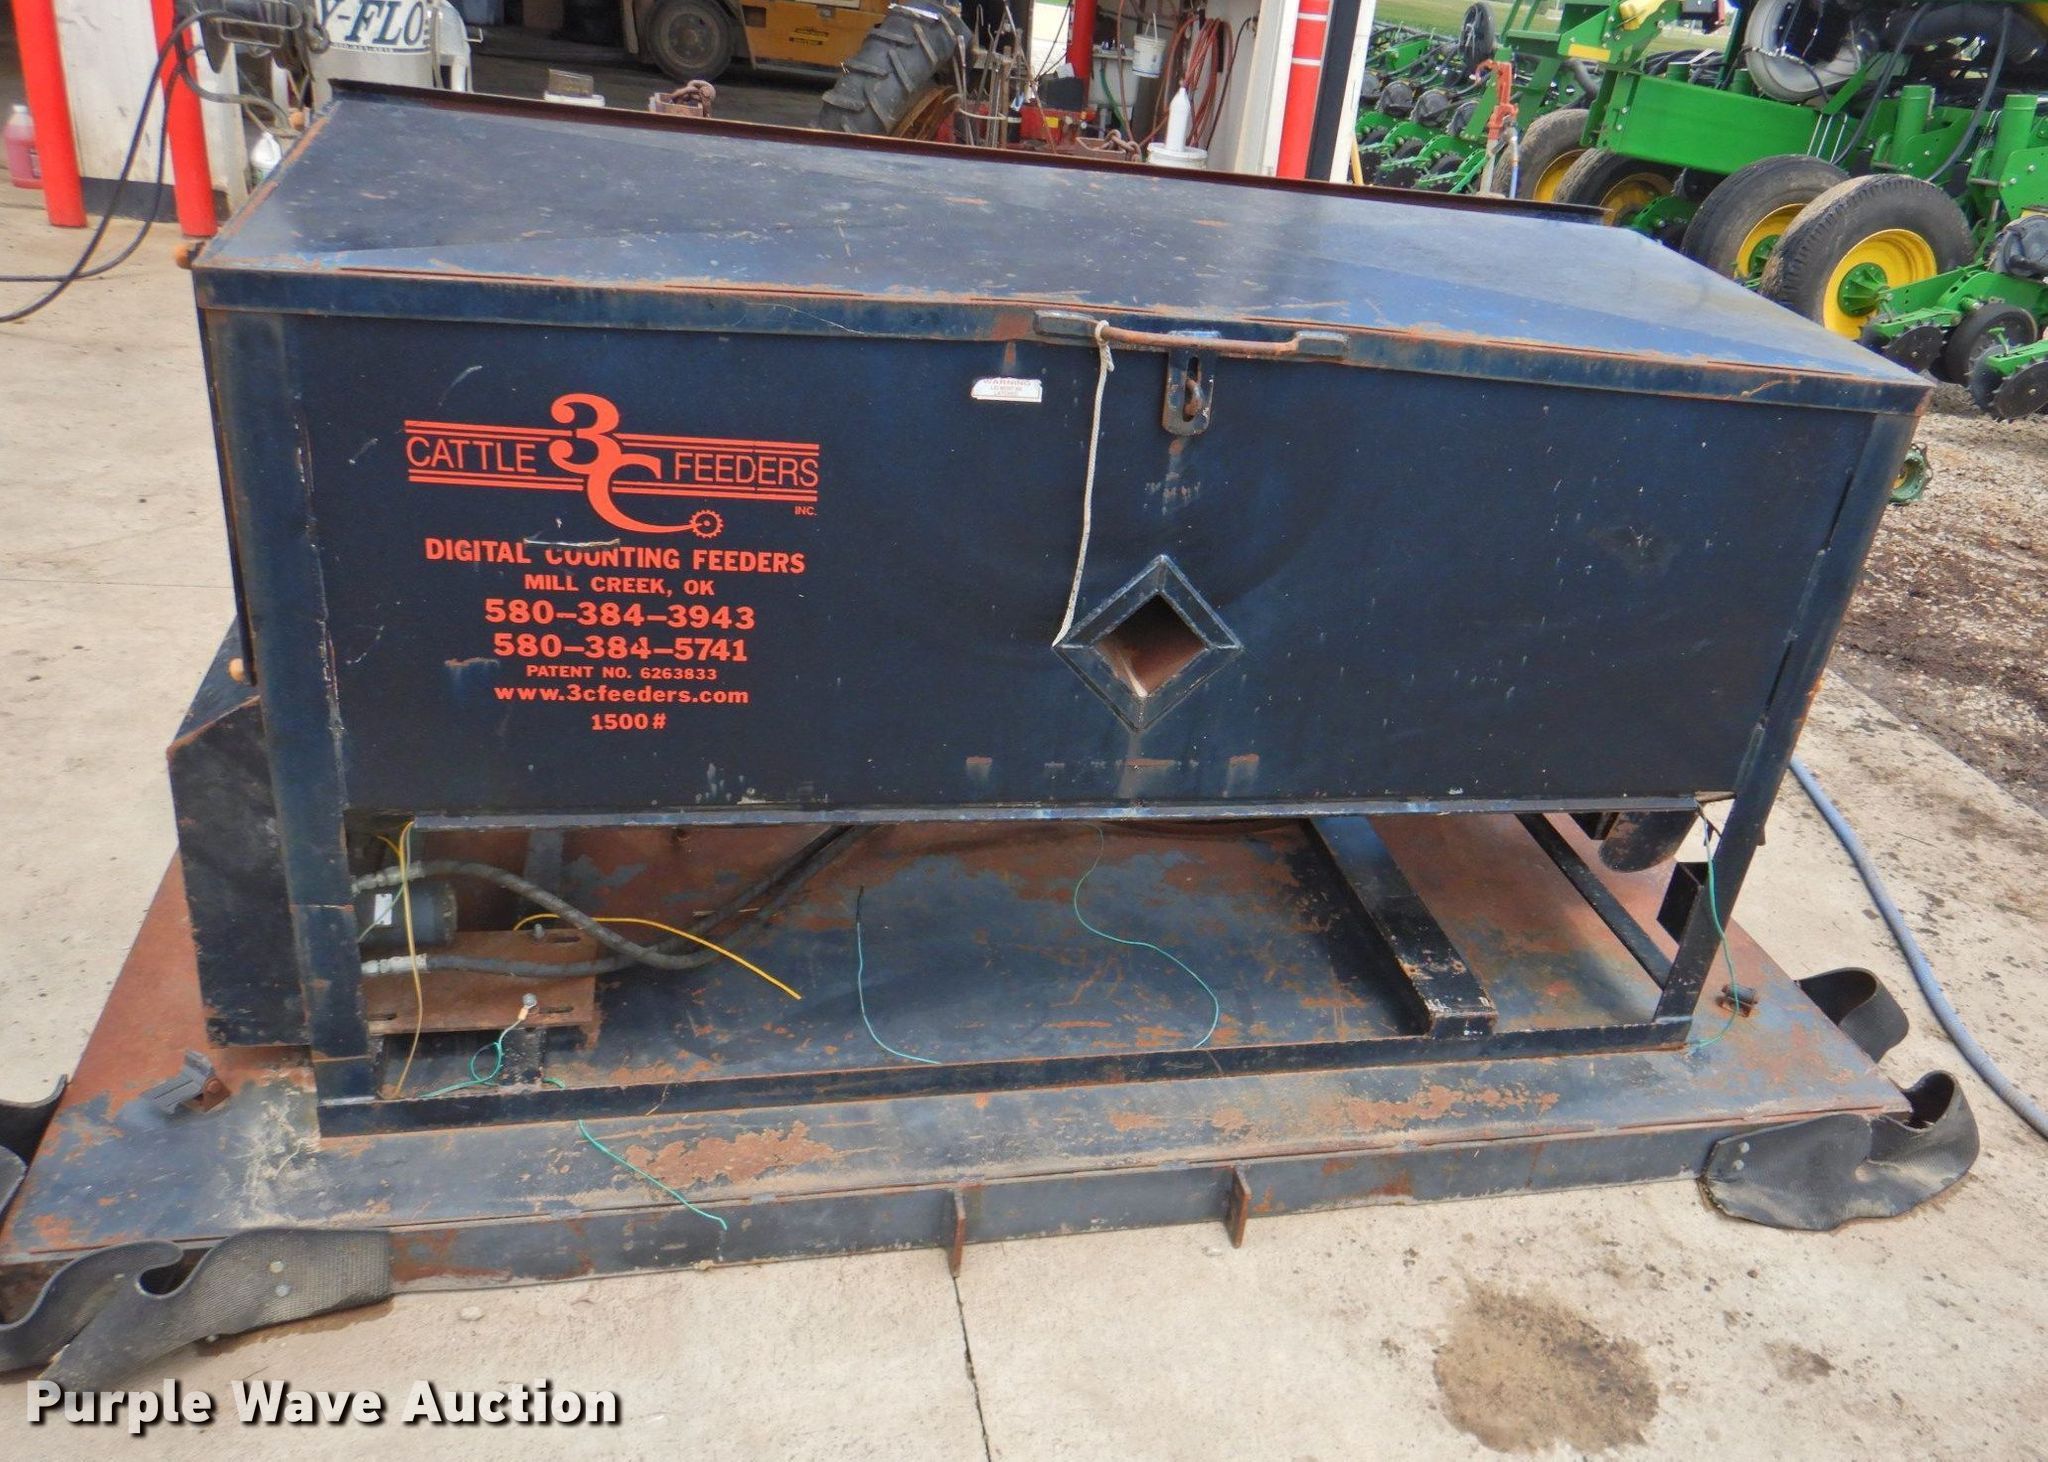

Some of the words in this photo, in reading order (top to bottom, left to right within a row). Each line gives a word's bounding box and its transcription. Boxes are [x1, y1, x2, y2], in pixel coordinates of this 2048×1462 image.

[406, 436, 537, 473] CATTLE
[548, 393, 695, 534] 3C
[674, 451, 819, 488] FEEDERS
[795, 505, 818, 517] INC.
[425, 537, 532, 564] DIGITAL
[545, 546, 681, 570] COUNTING
[692, 549, 806, 573] FEEDERS
[524, 574, 579, 592] MILL
[590, 576, 673, 597] CREEK,
[683, 579, 715, 596] OK
[485, 599, 756, 630] 580-384-3943
[493, 632, 748, 662] 580-384-5741
[526, 664, 594, 678] PATENT
[602, 666, 632, 680] NO.
[639, 667, 718, 681] 6263833
[494, 684, 749, 704] www.3cfeeders.com
